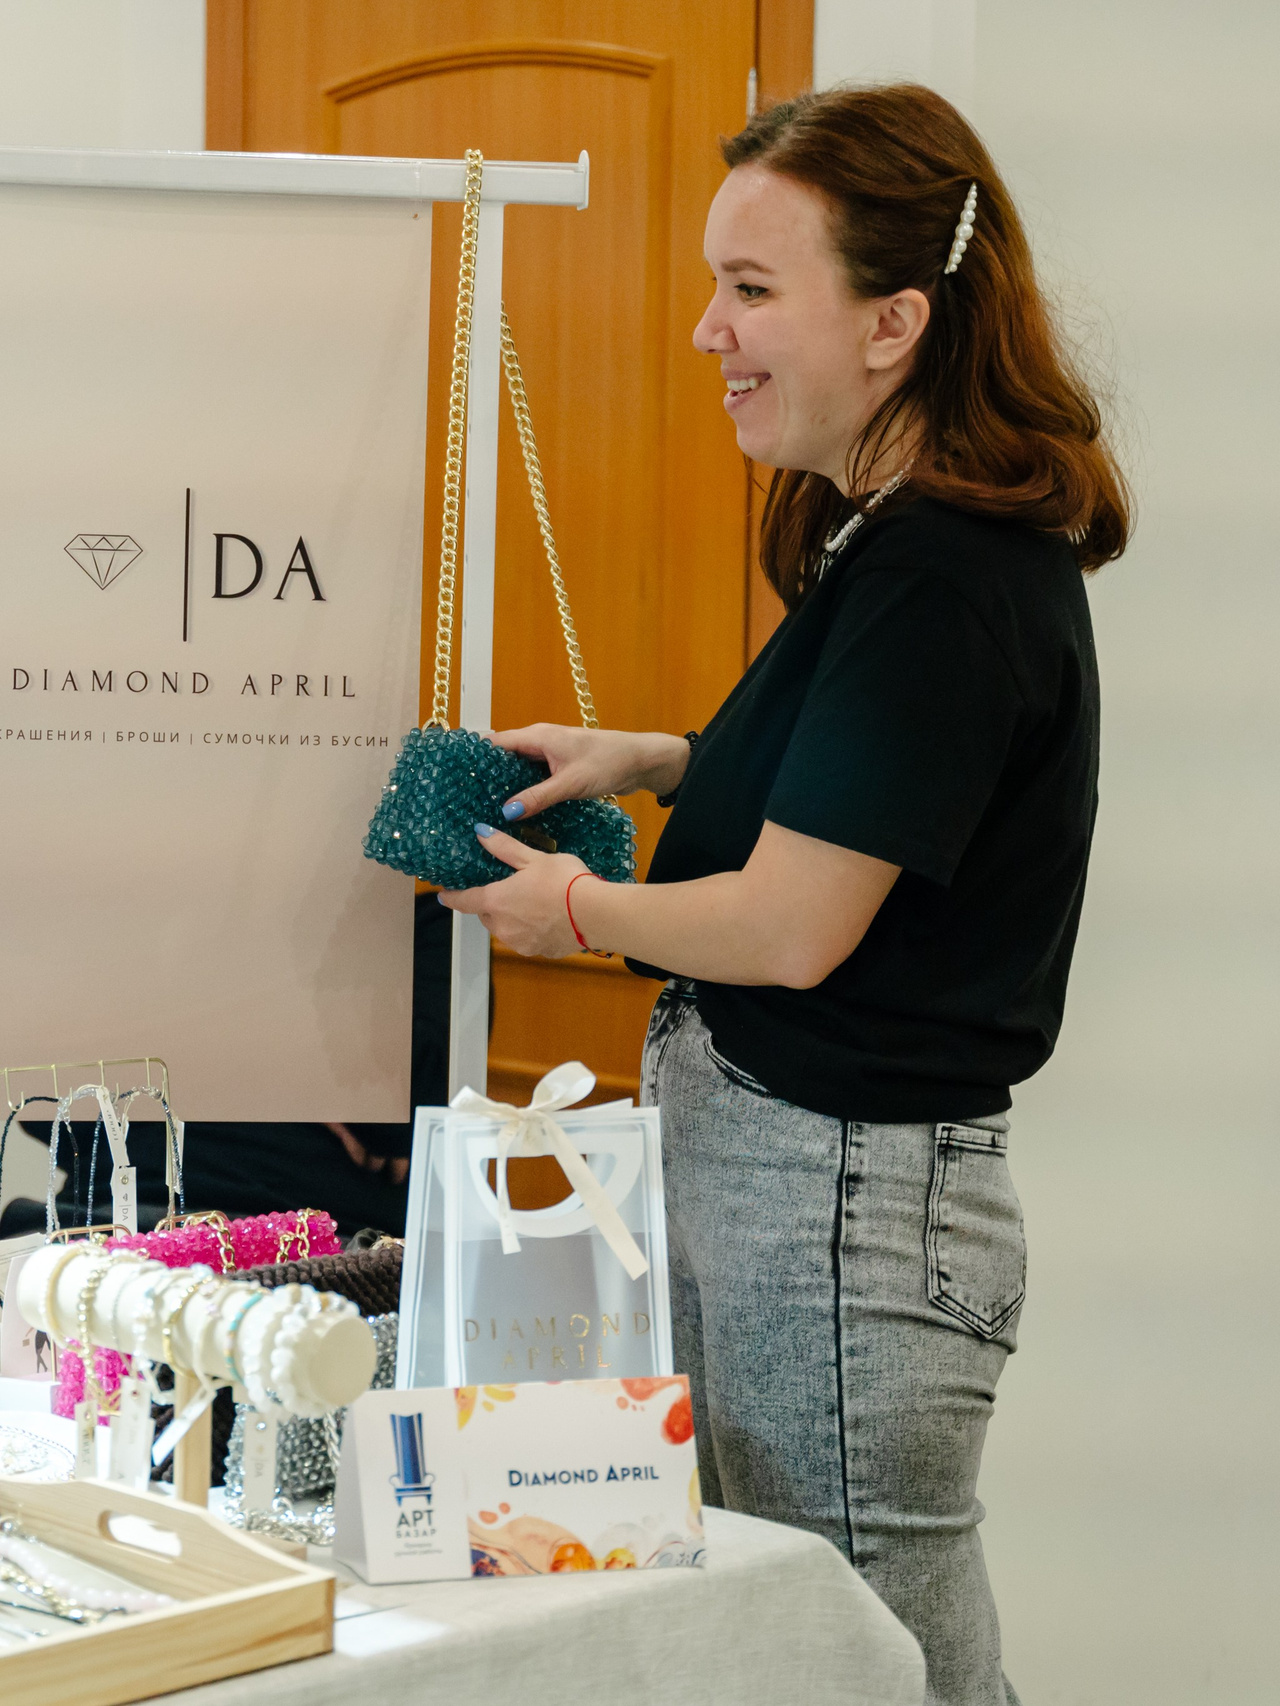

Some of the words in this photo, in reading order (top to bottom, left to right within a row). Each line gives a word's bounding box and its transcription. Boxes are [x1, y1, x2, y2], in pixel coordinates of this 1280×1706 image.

[211, 532, 327, 602] DA
[11, 667, 211, 696] DIAMOND
[240, 673, 356, 699] APRIL
[116, 731, 180, 743] БРОШИ
[203, 732, 290, 746] СУМОЧКИ
[300, 734, 321, 747] ИЗ
[331, 735, 389, 748] БУСИН
[465, 1312, 651, 1342] DIAMOND
[502, 1344, 611, 1370] APRIL
[396, 1509, 434, 1528] АРТ
